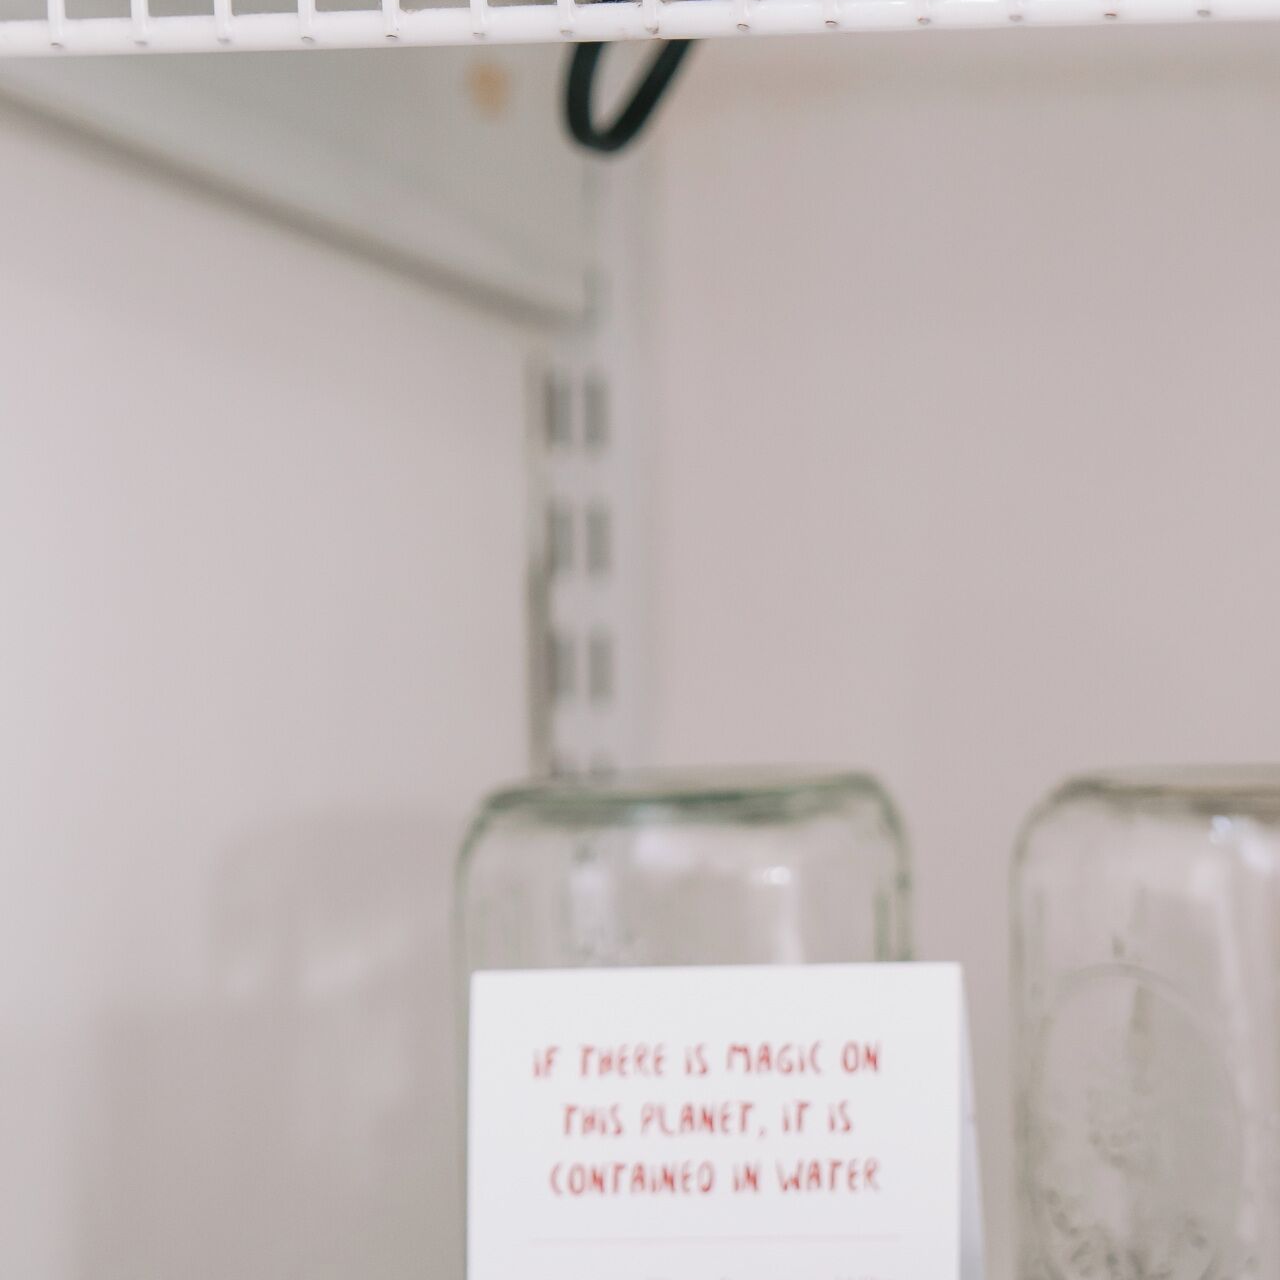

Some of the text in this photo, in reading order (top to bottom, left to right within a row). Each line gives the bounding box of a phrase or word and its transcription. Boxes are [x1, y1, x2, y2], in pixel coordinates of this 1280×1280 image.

[579, 1043, 665, 1078] THERE
[684, 1043, 709, 1077] IS
[726, 1040, 822, 1077] MAGIC
[841, 1040, 880, 1075] ON
[563, 1103, 624, 1138] THIS
[641, 1100, 766, 1139] PLANET,
[549, 1160, 716, 1197] CONTAINED
[777, 1158, 879, 1194] WATER
